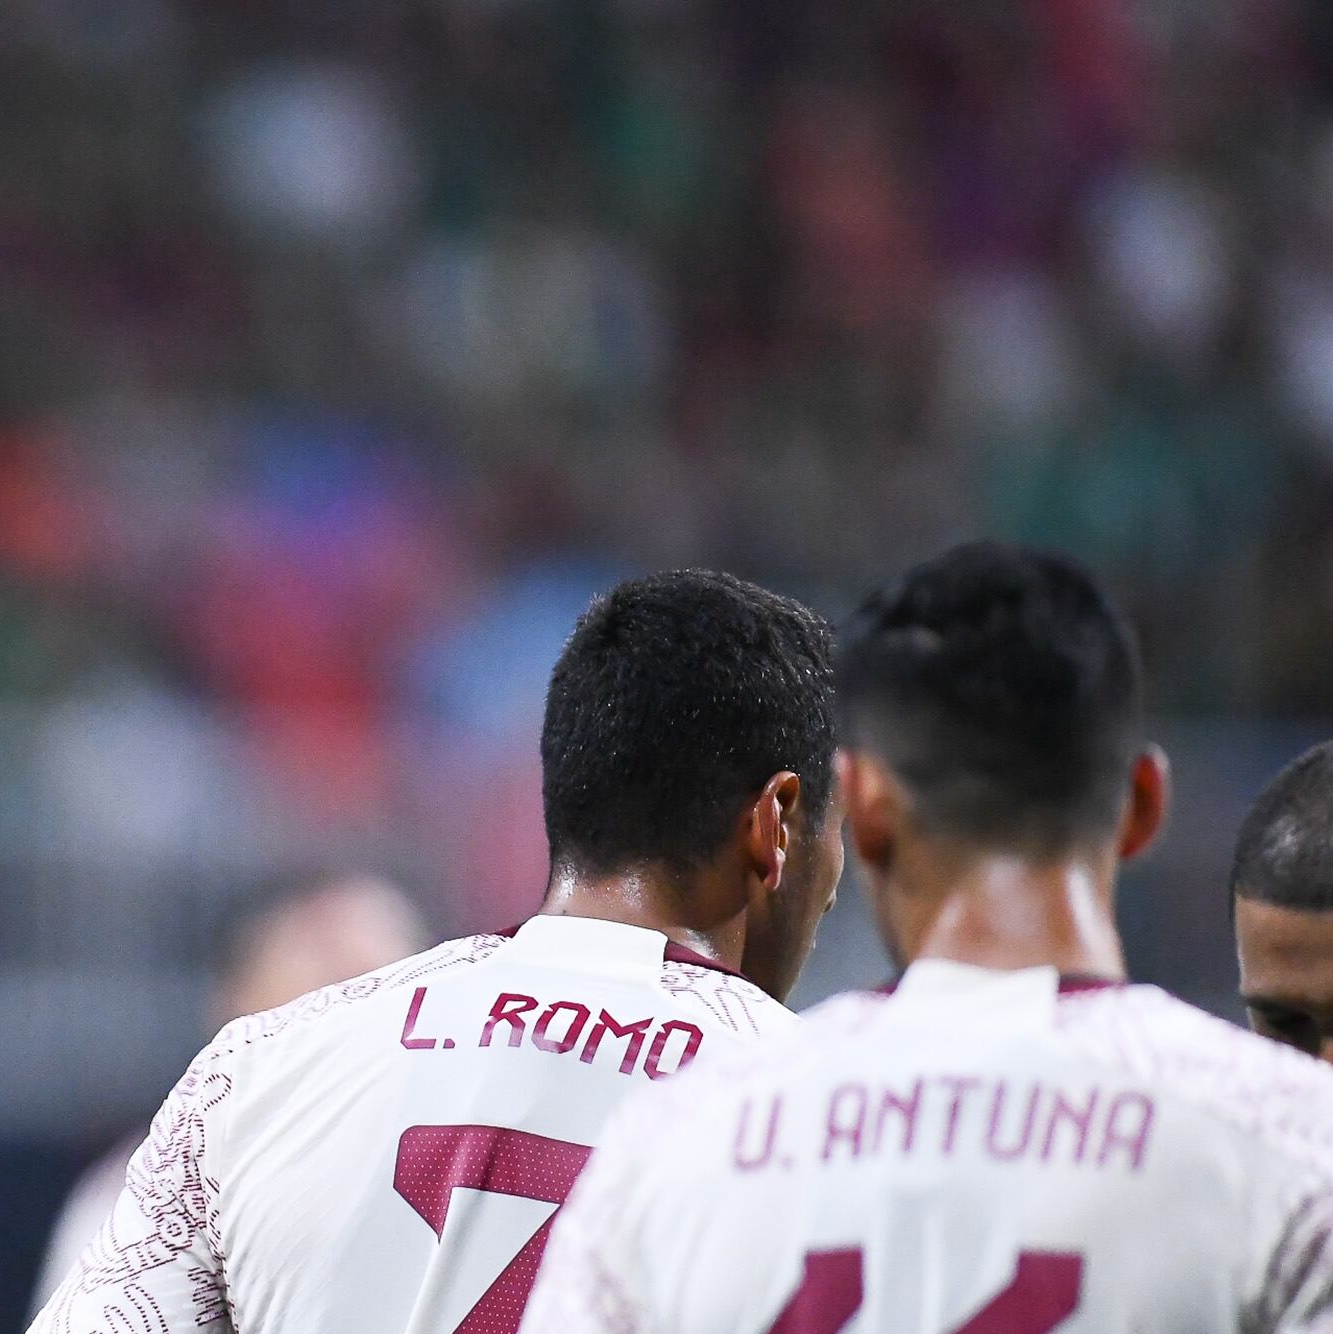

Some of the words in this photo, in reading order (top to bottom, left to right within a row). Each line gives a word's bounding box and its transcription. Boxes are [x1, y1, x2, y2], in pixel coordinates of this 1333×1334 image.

[400, 986, 455, 1050] L.
[478, 991, 704, 1081] ROMO
[734, 1096, 794, 1173] U.
[821, 1074, 1156, 1173] ANTUNA
